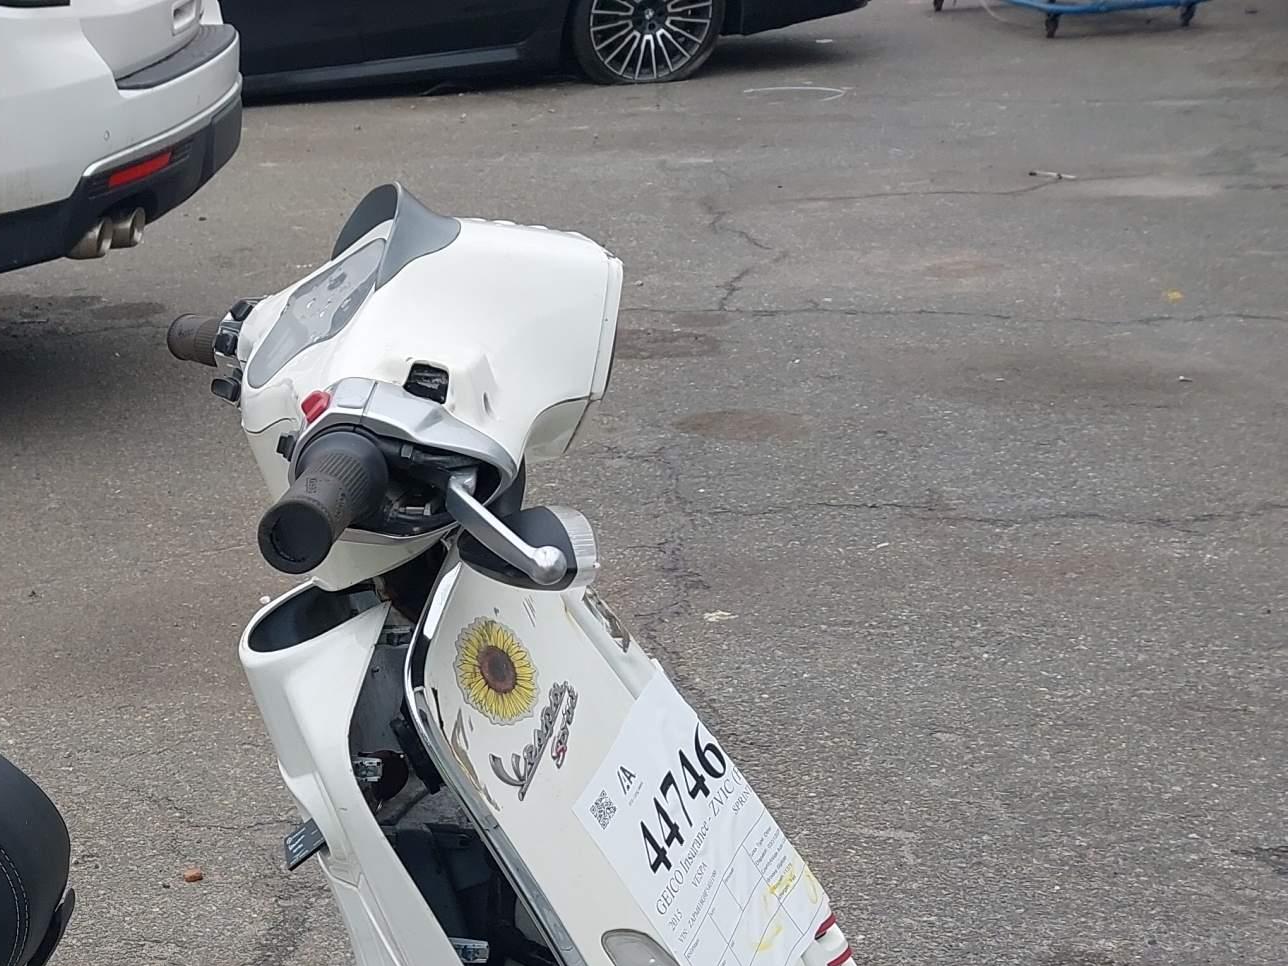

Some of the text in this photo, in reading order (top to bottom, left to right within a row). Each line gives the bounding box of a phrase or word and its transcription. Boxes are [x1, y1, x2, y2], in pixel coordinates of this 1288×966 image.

[489, 681, 569, 801] Vespa
[640, 722, 727, 874] 44746
[656, 869, 684, 915] GEICO
[679, 821, 710, 874] Insurance
[708, 778, 735, 817] ZVIC
[668, 908, 684, 931] 2015
[691, 862, 709, 888] VESPA
